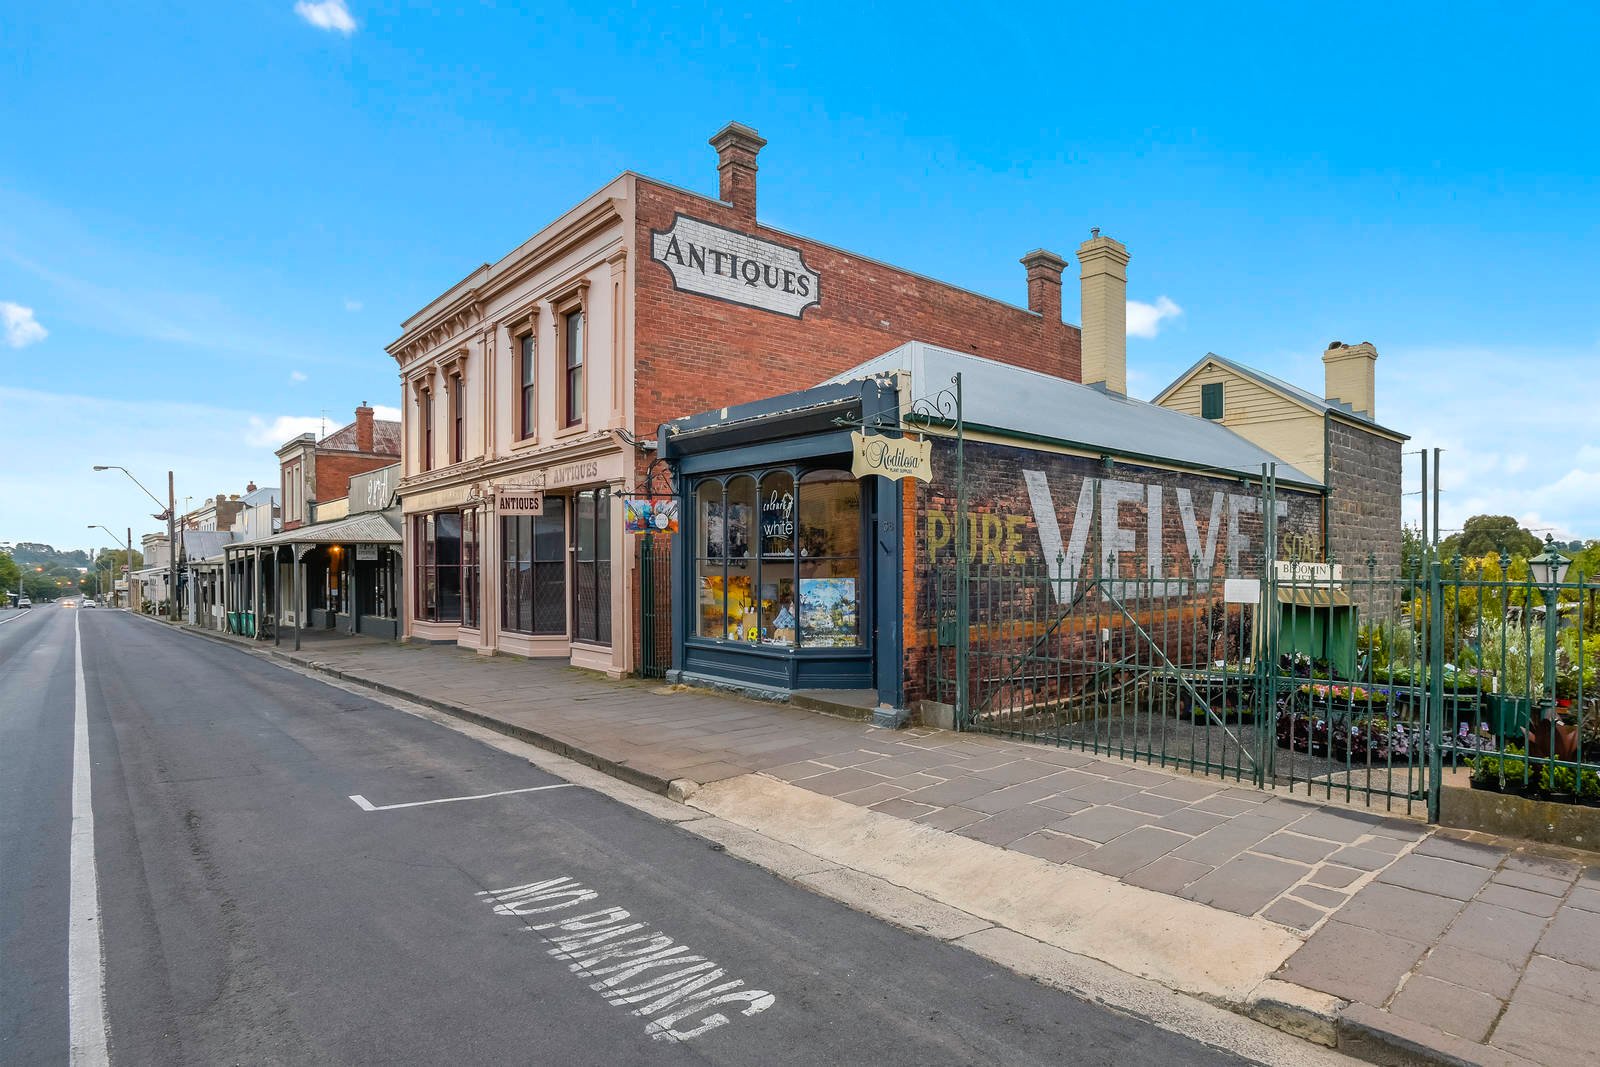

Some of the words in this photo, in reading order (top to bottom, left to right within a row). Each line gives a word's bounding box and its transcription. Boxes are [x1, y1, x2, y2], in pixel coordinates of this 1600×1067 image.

[663, 234, 810, 297] ANTIQUES
[866, 440, 919, 470] Rodilosa
[553, 461, 598, 484] ANTIQUES
[500, 497, 539, 510] ANTIQUES
[763, 520, 793, 535] white
[927, 509, 1026, 564] PURE
[1022, 469, 1289, 605] VELVET
[474, 876, 599, 915] NO
[518, 905, 776, 1042] PARKING
